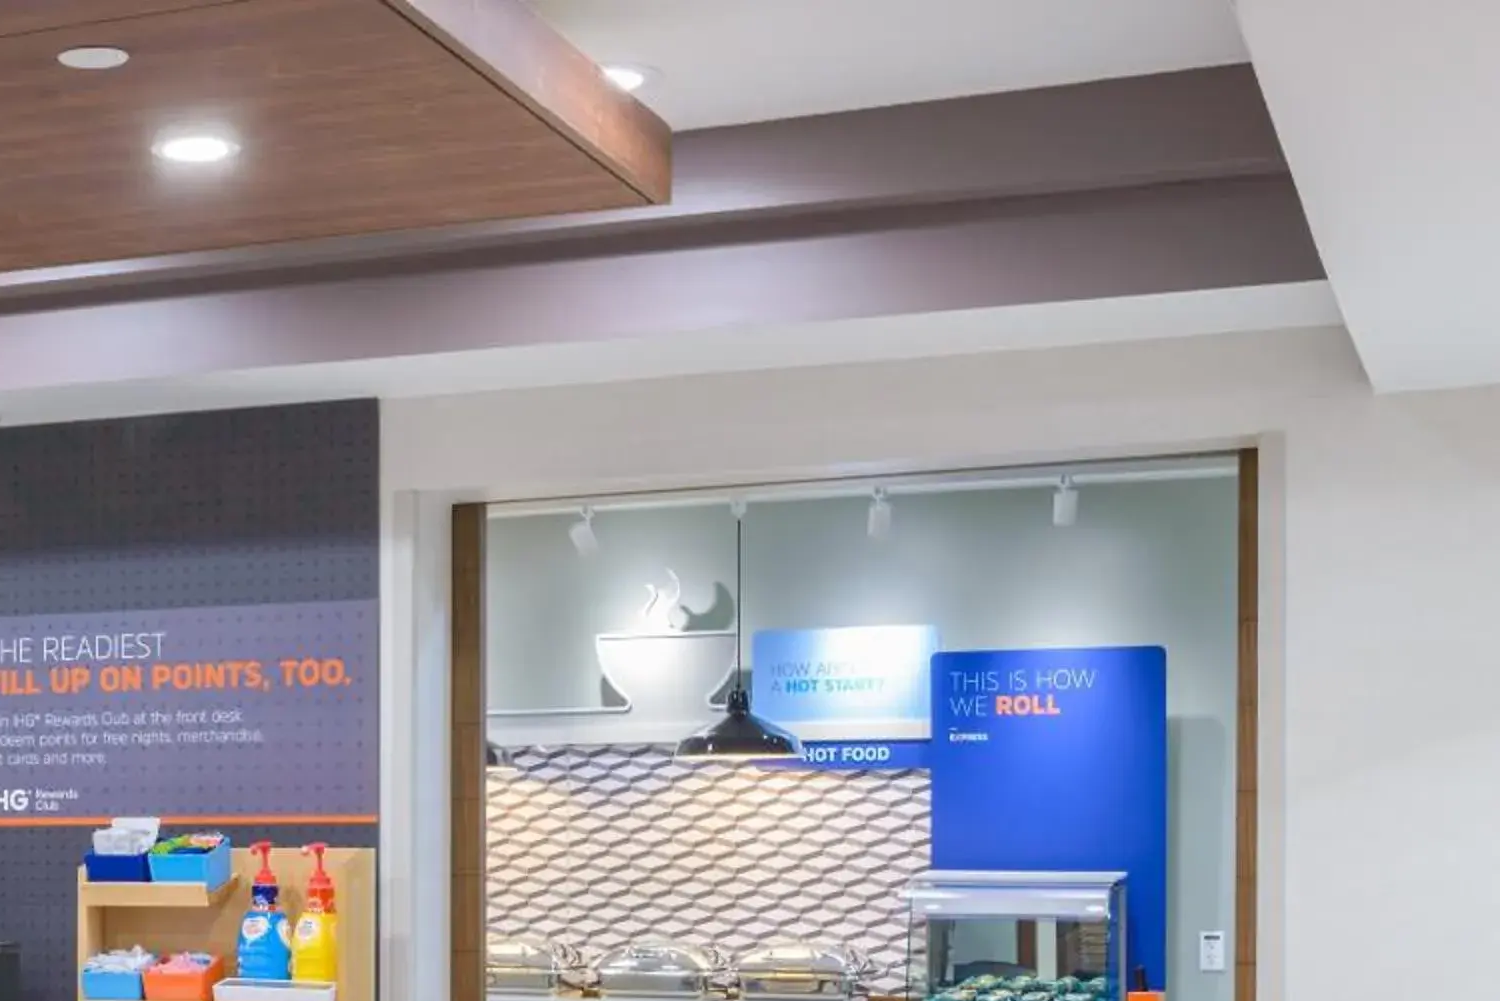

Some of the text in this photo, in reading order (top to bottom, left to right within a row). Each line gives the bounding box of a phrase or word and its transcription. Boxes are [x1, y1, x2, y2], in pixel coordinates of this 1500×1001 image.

[43, 632, 166, 661] READIEST
[50, 667, 91, 694] UP
[100, 665, 143, 692] ON
[151, 660, 271, 692] POINTS,
[279, 657, 352, 687] TOO.
[950, 668, 1095, 691] THIS IS HOW
[785, 679, 819, 694] HOT
[950, 694, 1061, 716] WE ROLL
[45, 713, 98, 727] Rewards
[101, 711, 129, 725] Club
[133, 712, 147, 725] at
[150, 711, 172, 725] the
[176, 710, 207, 724] front
[39, 733, 77, 748] points
[81, 732, 98, 745] for
[103, 732, 128, 745] free
[7, 751, 39, 765] cards
[43, 752, 68, 764] and
[803, 746, 891, 762] HOT FOOD
[35, 787, 79, 800] Rewards
[35, 800, 60, 811] Club
